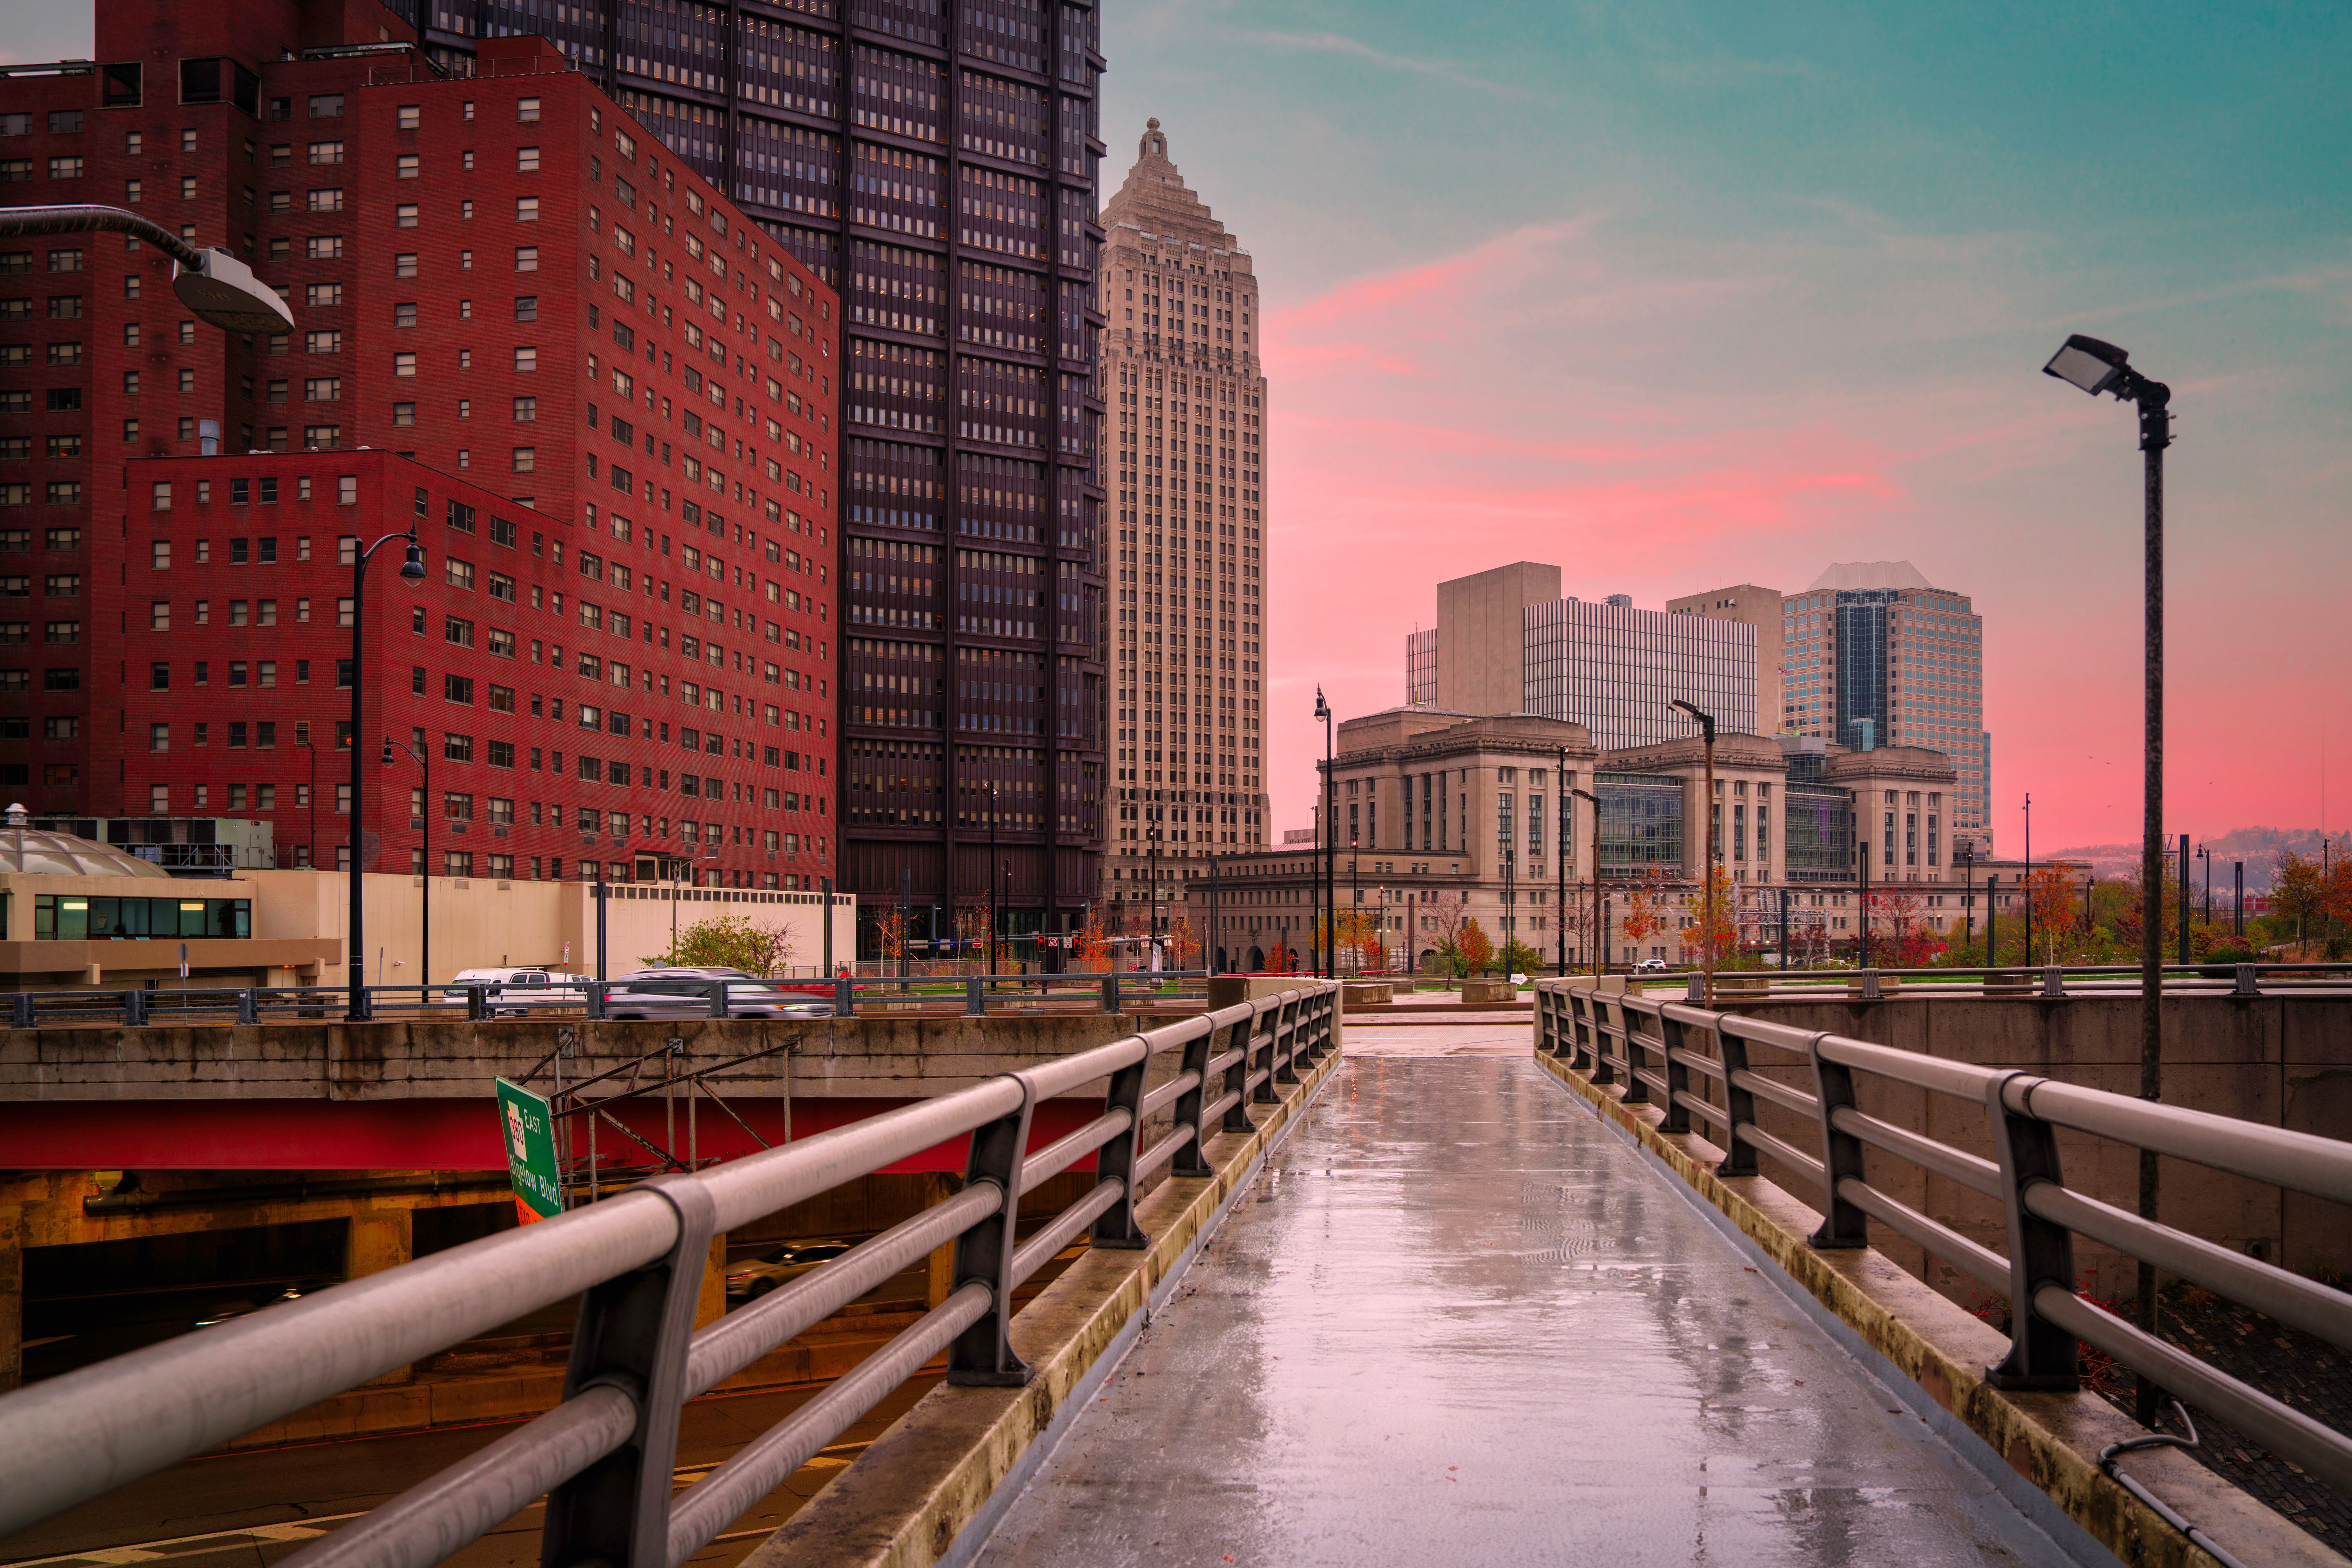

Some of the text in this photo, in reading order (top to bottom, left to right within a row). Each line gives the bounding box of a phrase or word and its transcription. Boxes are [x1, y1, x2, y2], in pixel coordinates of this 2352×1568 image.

[510, 1115, 523, 1145] 380
[524, 1108, 540, 1135] EAST
[509, 1153, 558, 1206] Bigelow Blvd
[519, 1204, 530, 1226] EXIT
